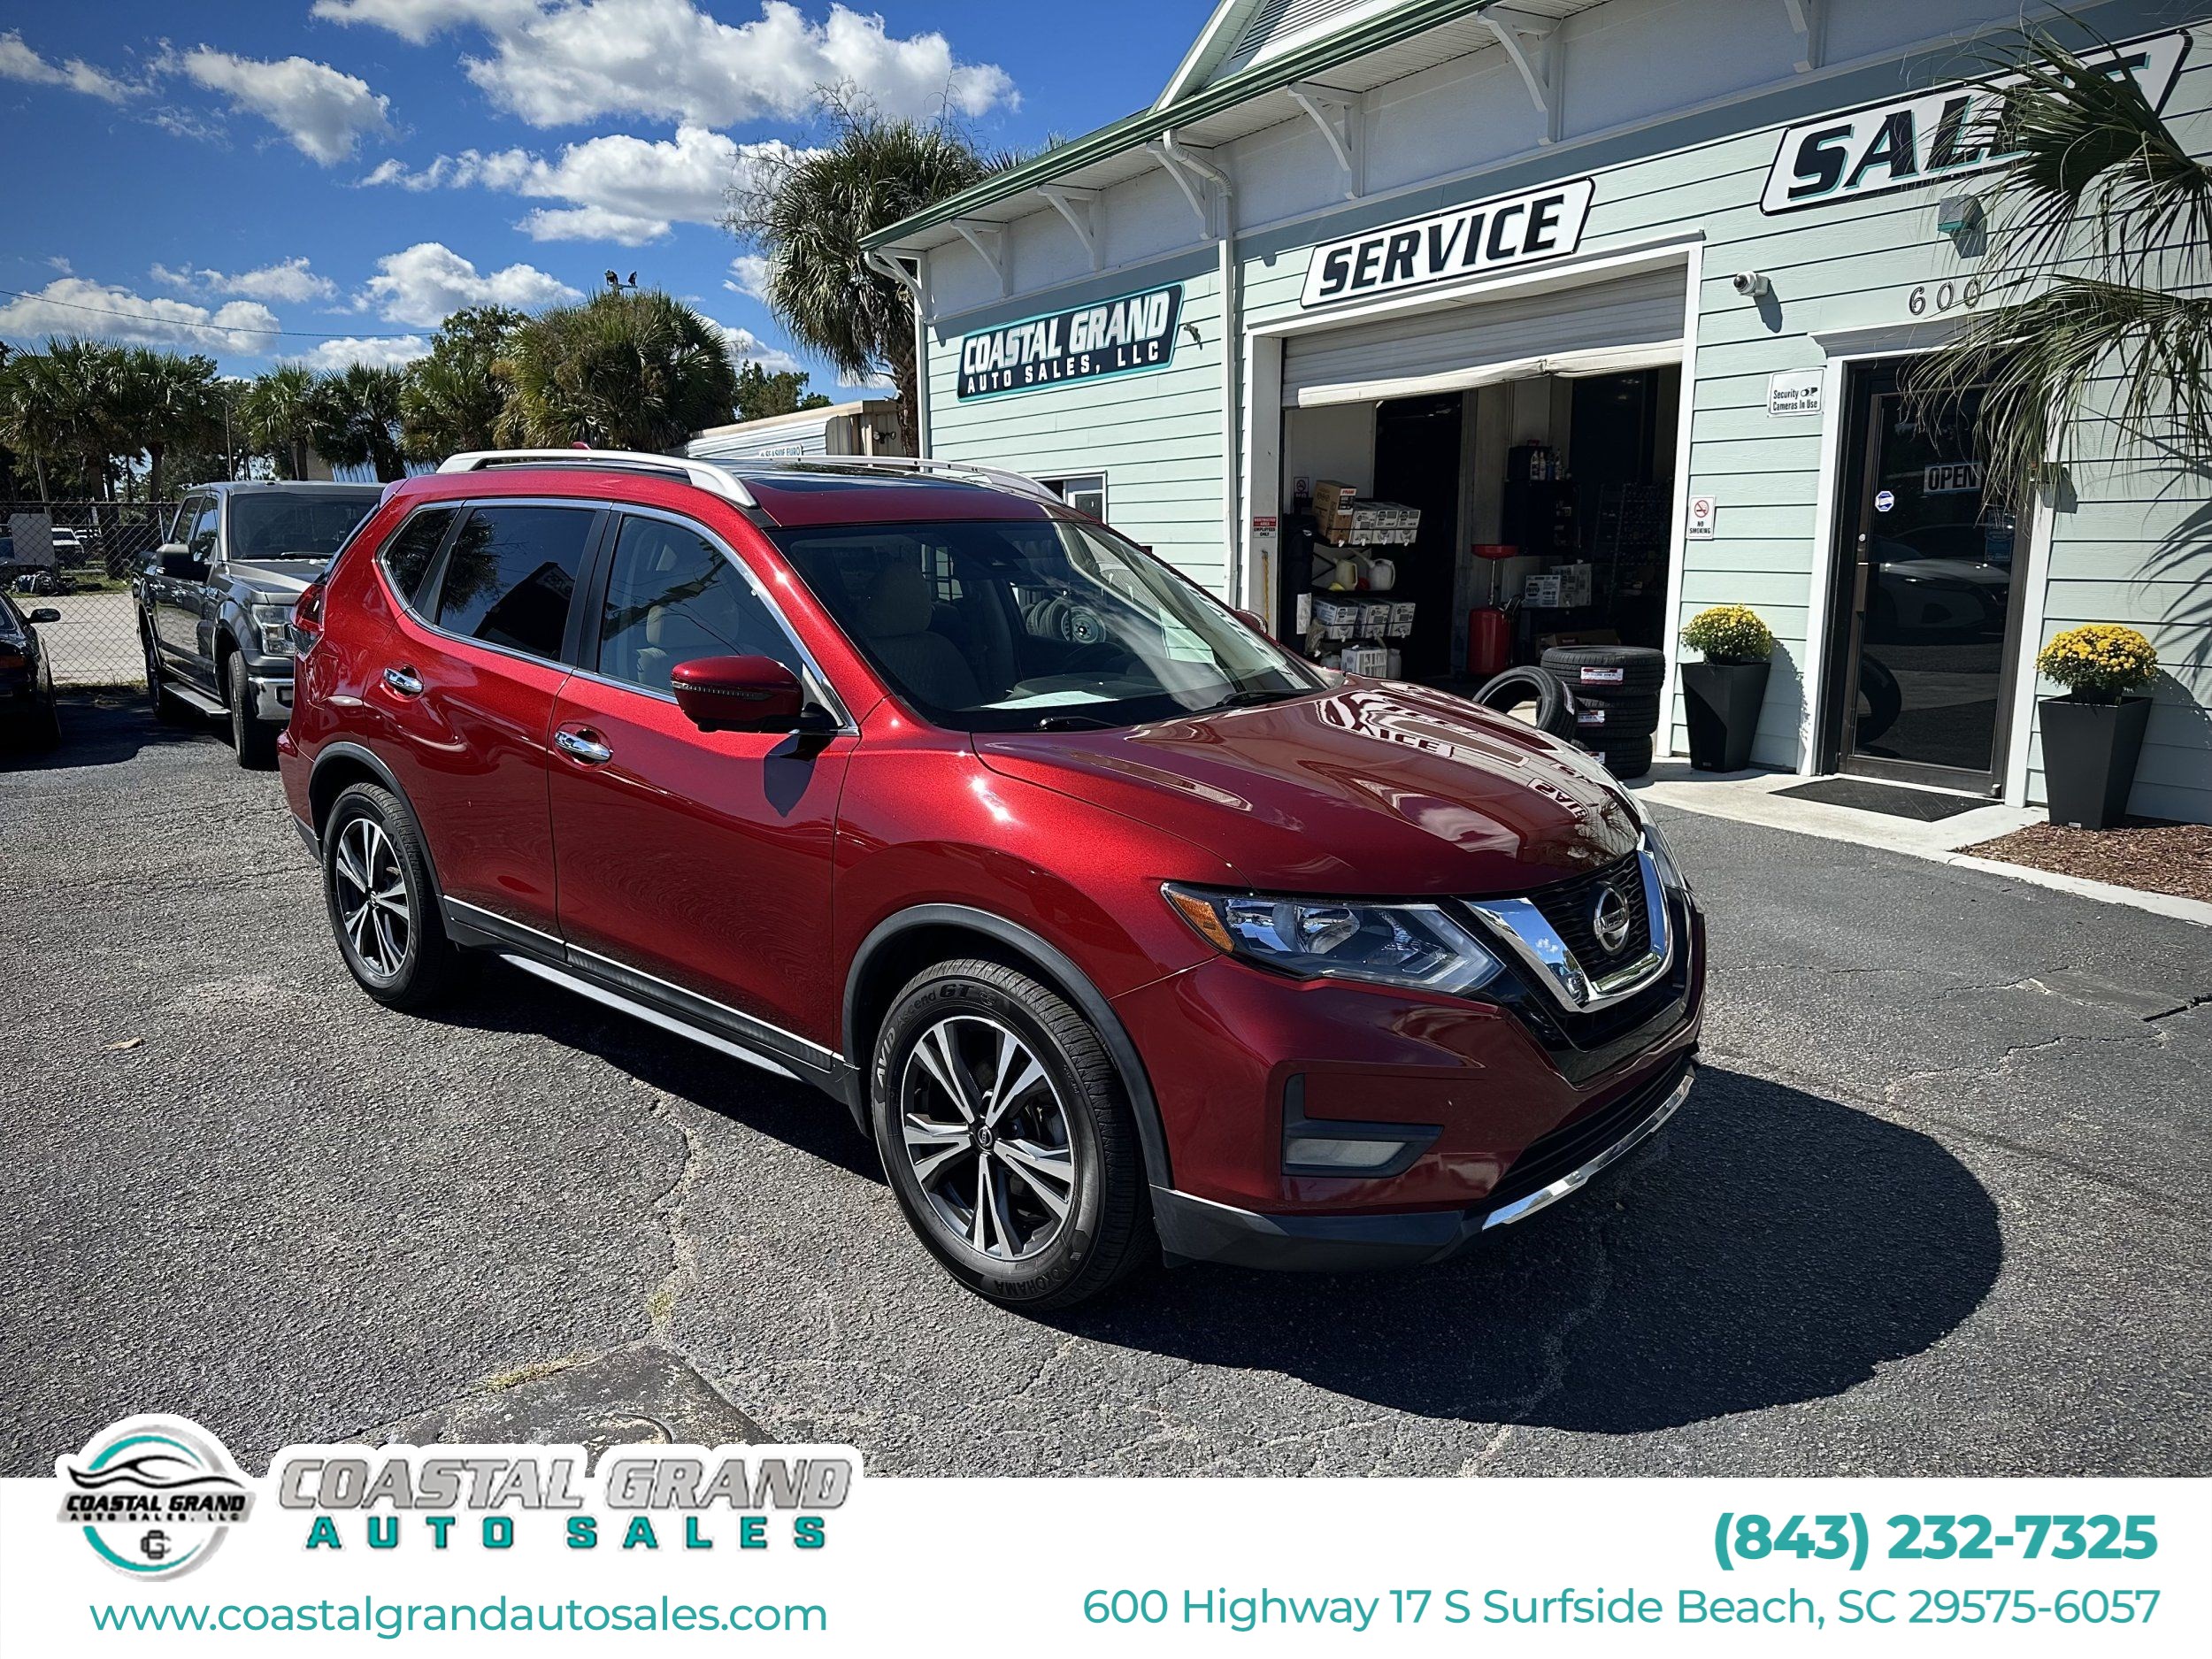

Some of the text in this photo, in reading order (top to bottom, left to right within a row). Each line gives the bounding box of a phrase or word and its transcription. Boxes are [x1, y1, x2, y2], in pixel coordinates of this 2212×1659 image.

[1787, 51, 2152, 201] SAL
[1319, 193, 1565, 296] SERVICE
[1909, 278, 1981, 316] 600
[963, 290, 1171, 376] COASTAL GRAND
[967, 340, 1159, 394] AUTO SALES, LLC
[1772, 399, 1818, 411] Cameras In Use
[1773, 388, 1799, 400] Security
[787, 446, 801, 457] EURO
[1927, 464, 1978, 491] OPEN
[876, 1026, 896, 1089] AVID
[939, 982, 975, 999] GT
